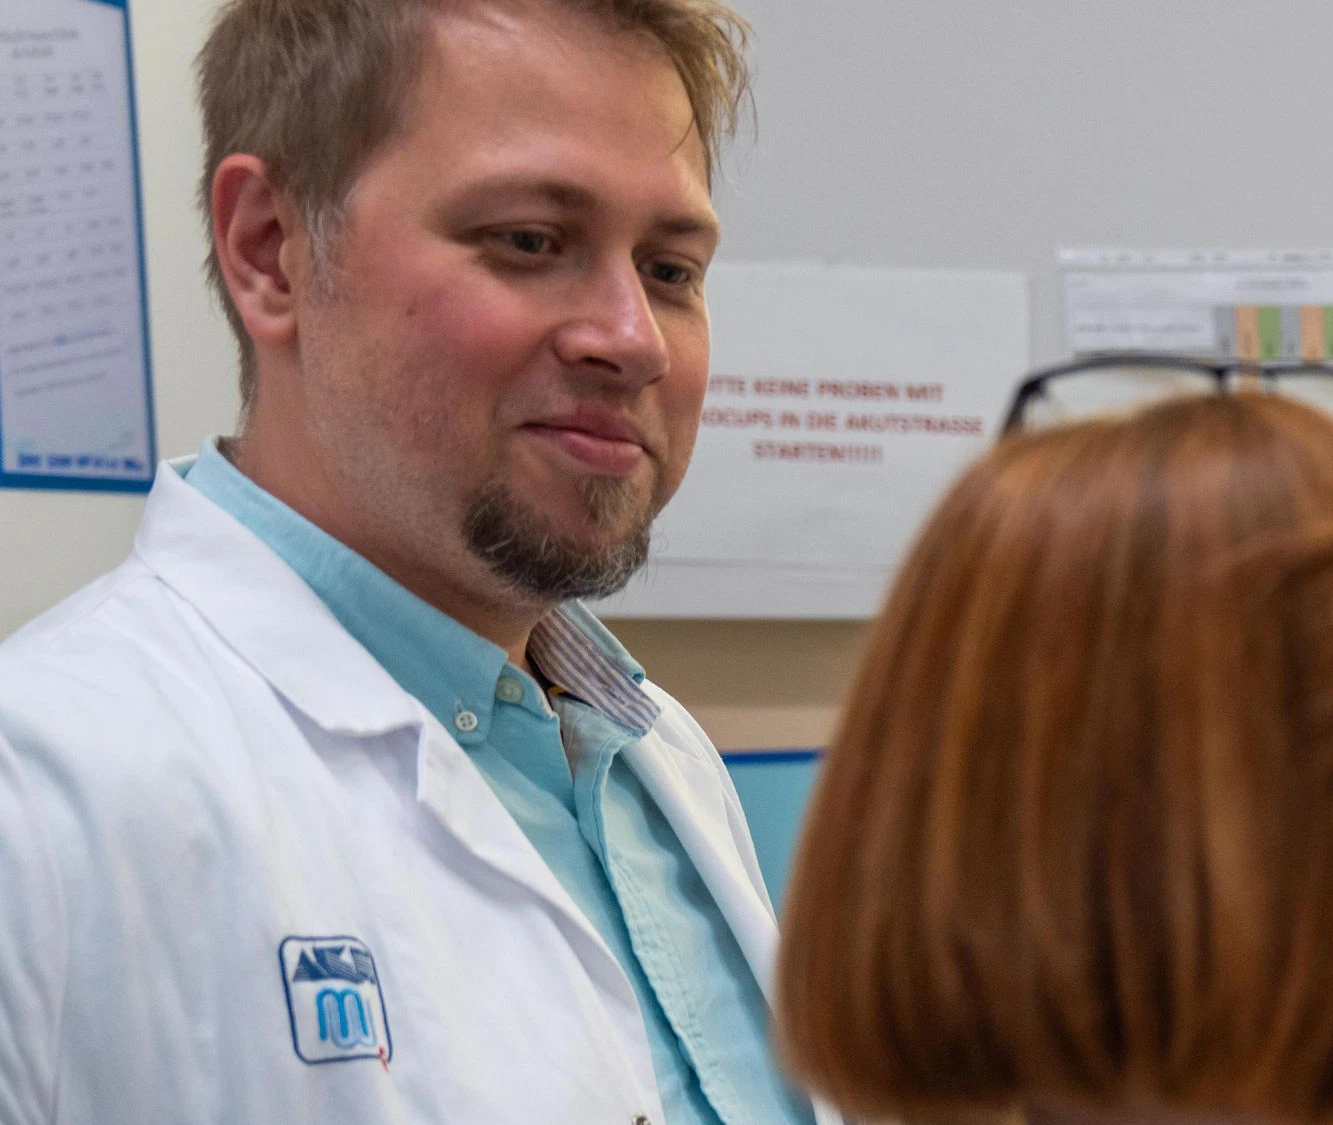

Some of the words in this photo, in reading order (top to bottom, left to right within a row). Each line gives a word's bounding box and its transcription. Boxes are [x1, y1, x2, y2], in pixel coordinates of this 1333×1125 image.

[709, 375, 747, 397] ITTE
[753, 377, 810, 399] KEINE
[817, 379, 900, 401] PROBEN
[905, 382, 945, 403] MIT
[778, 410, 801, 429] IN
[806, 411, 838, 431] DIE
